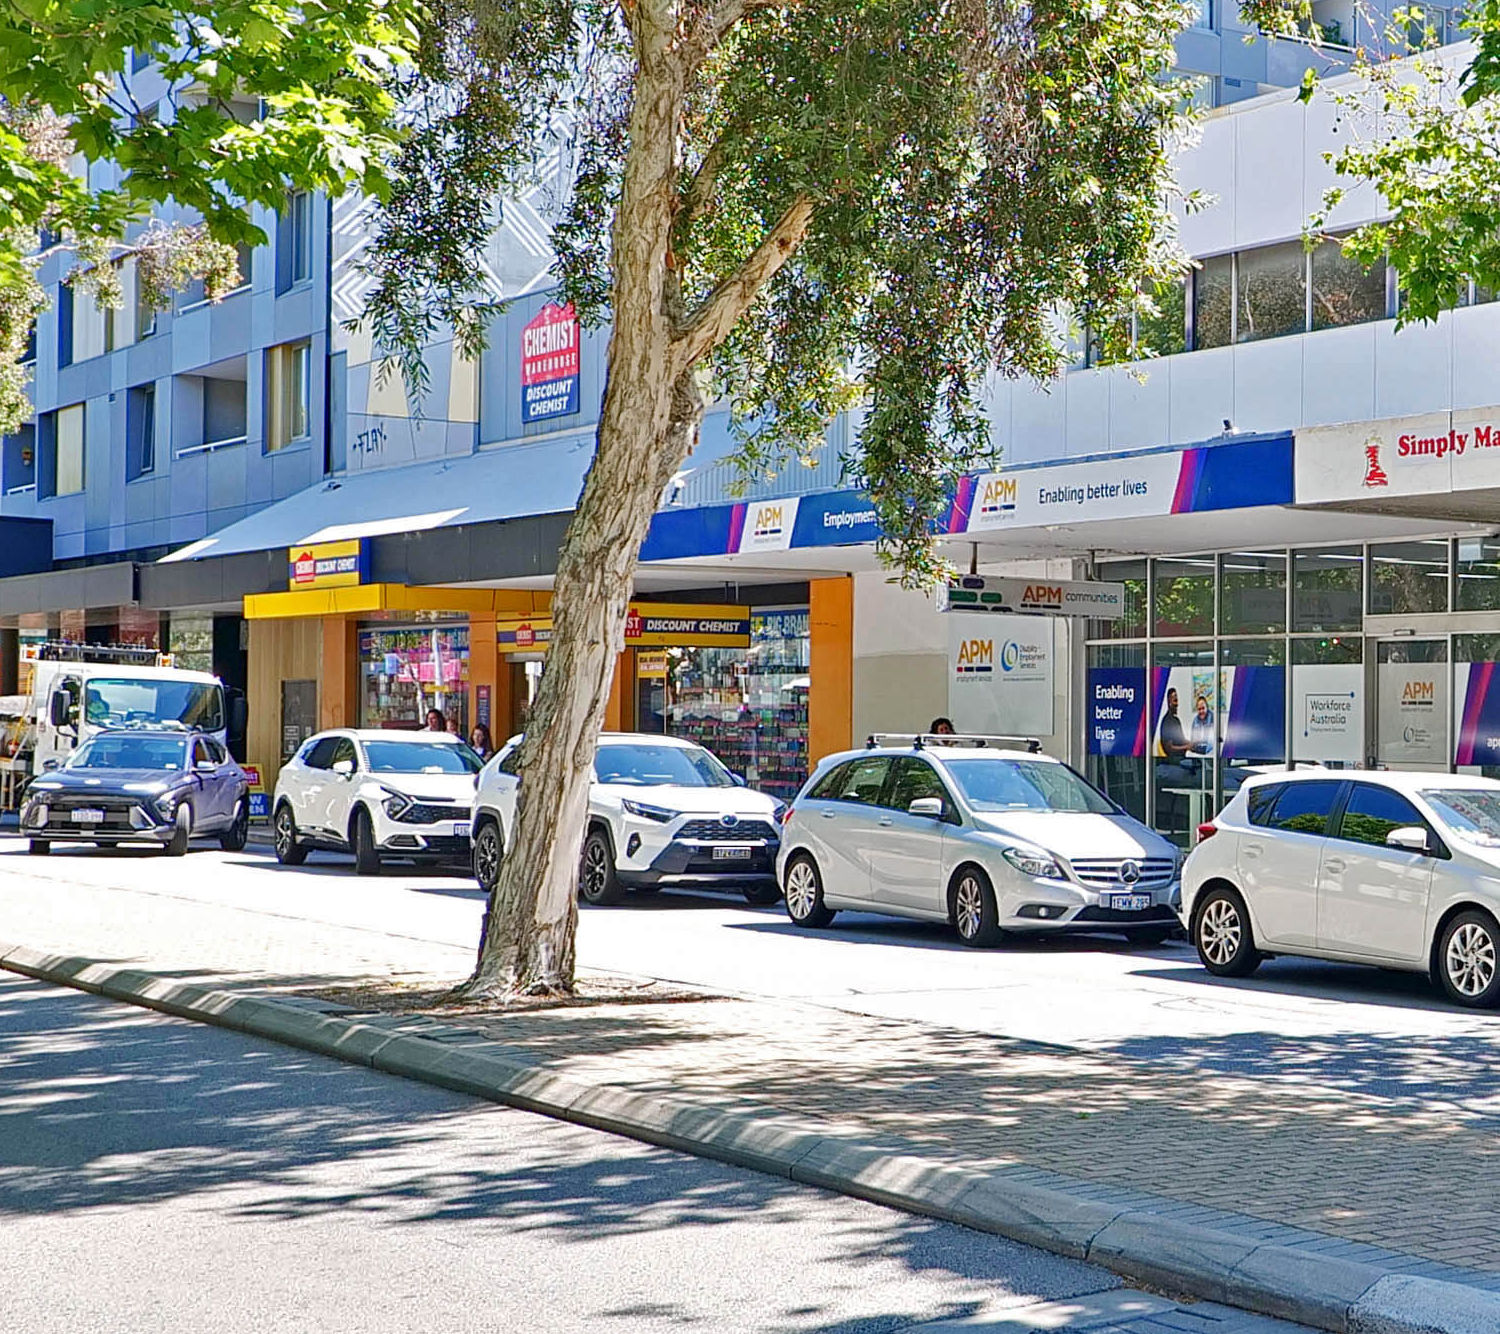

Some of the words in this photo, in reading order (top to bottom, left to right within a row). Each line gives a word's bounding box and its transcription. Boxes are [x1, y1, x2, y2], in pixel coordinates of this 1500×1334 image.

[524, 320, 575, 358] CHEMIST
[525, 352, 576, 376] WAREHOUSE
[526, 379, 572, 402] DISCOUNT
[529, 396, 568, 416] CHEMIST
[1398, 430, 1469, 458] Simply
[983, 479, 1016, 504] APM
[1039, 485, 1084, 505] Enabling
[1087, 482, 1121, 499] better
[1123, 479, 1148, 496] lives
[756, 506, 783, 529] APM
[1022, 585, 1063, 604] APM
[1065, 592, 1118, 604] communities
[647, 619, 697, 632] DISCOUNT
[699, 620, 740, 632] CHEMIST
[957, 639, 993, 664] APM
[1095, 684, 1134, 702] Enabling
[1402, 682, 1434, 699] APM
[1095, 705, 1123, 719] better
[1310, 700, 1351, 711] Workforce
[1310, 713, 1346, 724] Australia
[1095, 726, 1115, 740] lives
